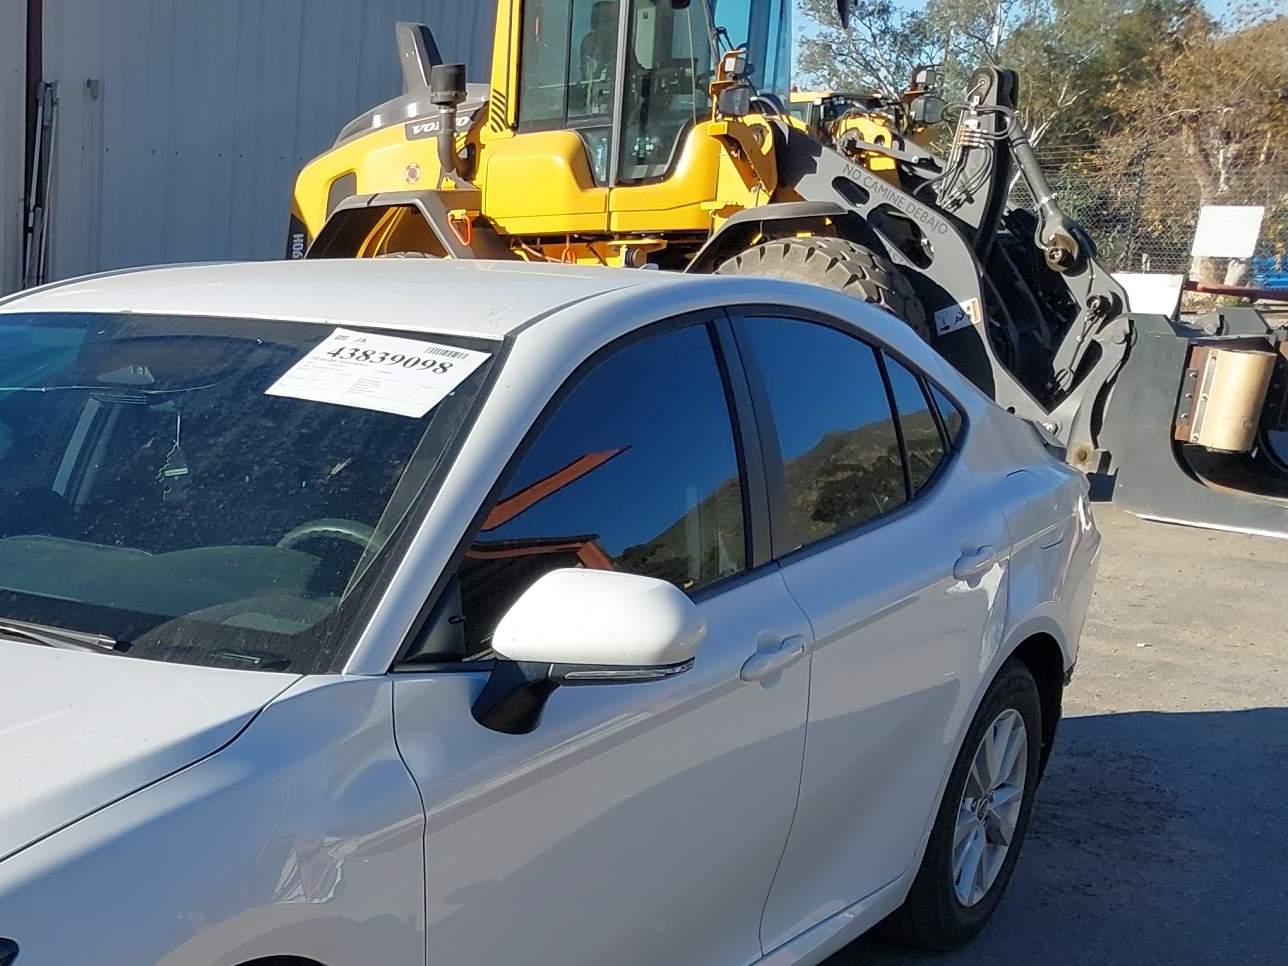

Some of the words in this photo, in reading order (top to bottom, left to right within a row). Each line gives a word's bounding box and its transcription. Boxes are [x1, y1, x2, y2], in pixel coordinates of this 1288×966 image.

[842, 163, 862, 181] NO
[863, 176, 906, 208] CAMINE
[906, 203, 949, 235] DEBAJO
[327, 346, 454, 375] 43839098
